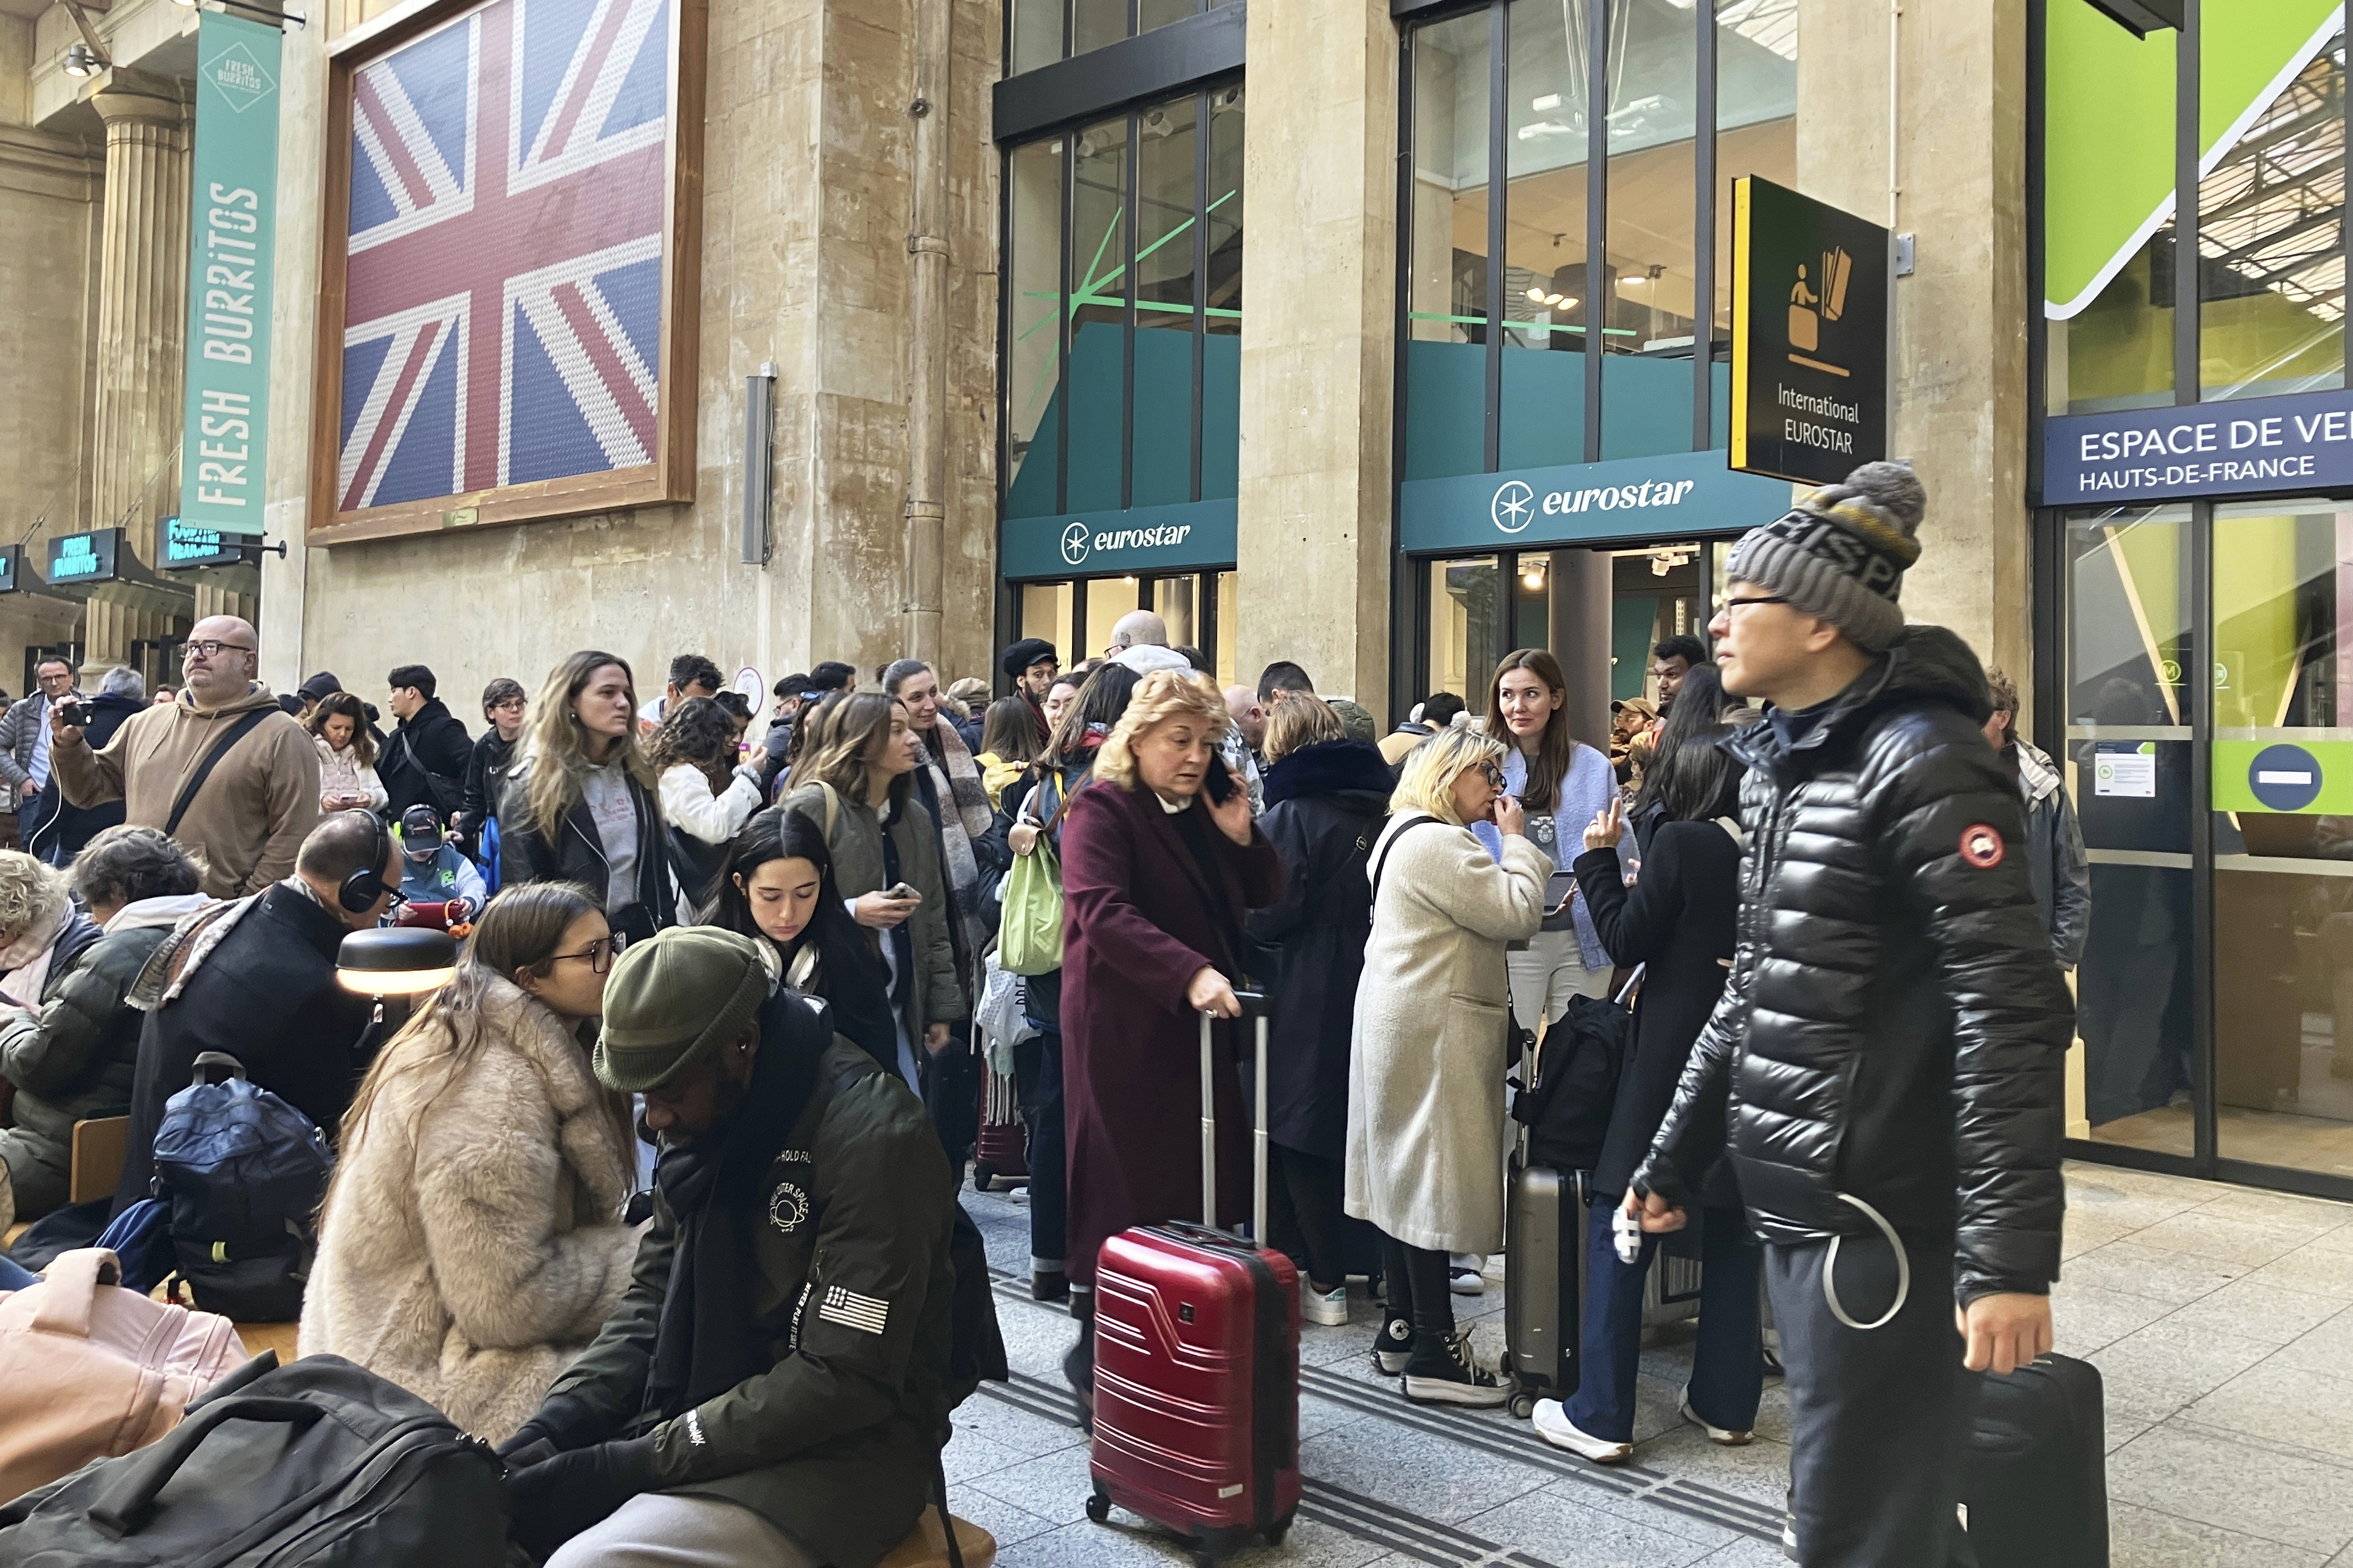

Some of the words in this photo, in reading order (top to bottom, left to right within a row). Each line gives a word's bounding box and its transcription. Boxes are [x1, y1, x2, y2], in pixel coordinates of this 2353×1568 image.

[1779, 382, 1859, 423] International
[198, 389, 250, 506] FRESH
[1785, 418, 1852, 454] EUROSTAR
[2081, 423, 2217, 461] ESPACE
[2231, 417, 2283, 449] DE
[2295, 411, 2353, 443] VE
[2080, 455, 2315, 491] HAUTS-DE-FRANCE
[1542, 478, 1694, 515] eurostar
[63, 535, 91, 558] FRESH
[1094, 522, 1191, 551] eurostar
[55, 552, 97, 577] BURRITOS
[792, 1188, 809, 1214] SPACE
[798, 1282, 812, 1307] NEVER
